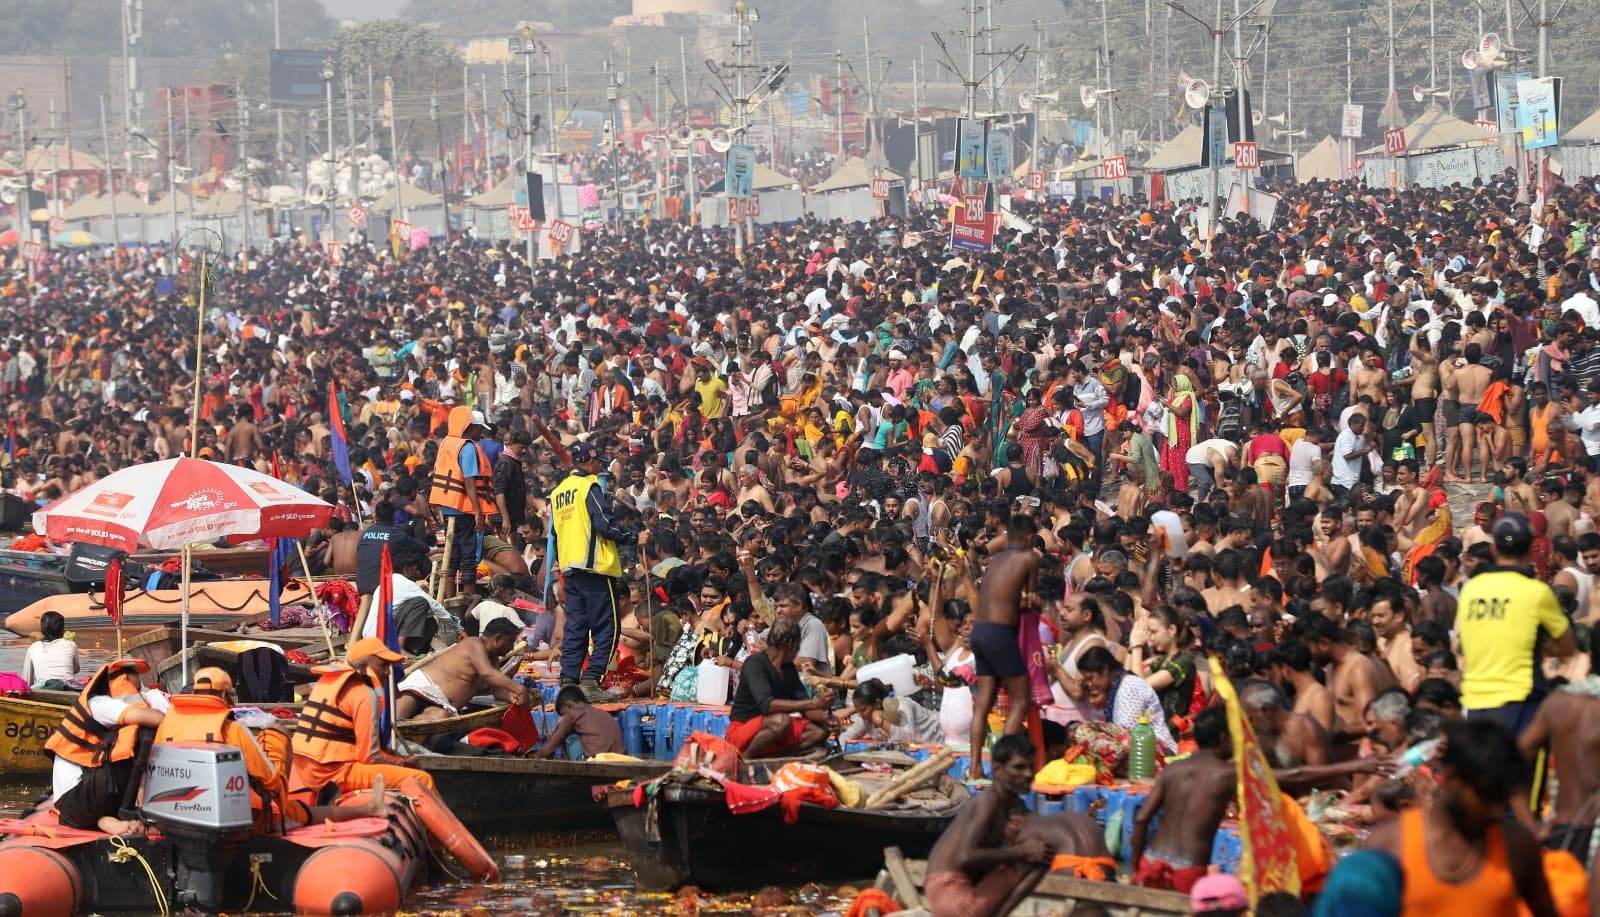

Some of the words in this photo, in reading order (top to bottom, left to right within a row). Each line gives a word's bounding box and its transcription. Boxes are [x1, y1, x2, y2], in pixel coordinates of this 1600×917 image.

[1386, 130, 1403, 152] 271
[1236, 143, 1256, 166] 260
[1104, 158, 1124, 178] 276
[966, 198, 984, 222] 258
[551, 221, 571, 242] 405
[556, 488, 578, 510] SDRF
[363, 531, 390, 541] POLICE
[1467, 598, 1511, 620] SDRF
[157, 766, 192, 780] TOHATSU
[225, 775, 245, 792] 40
[174, 802, 212, 812] EverRun
